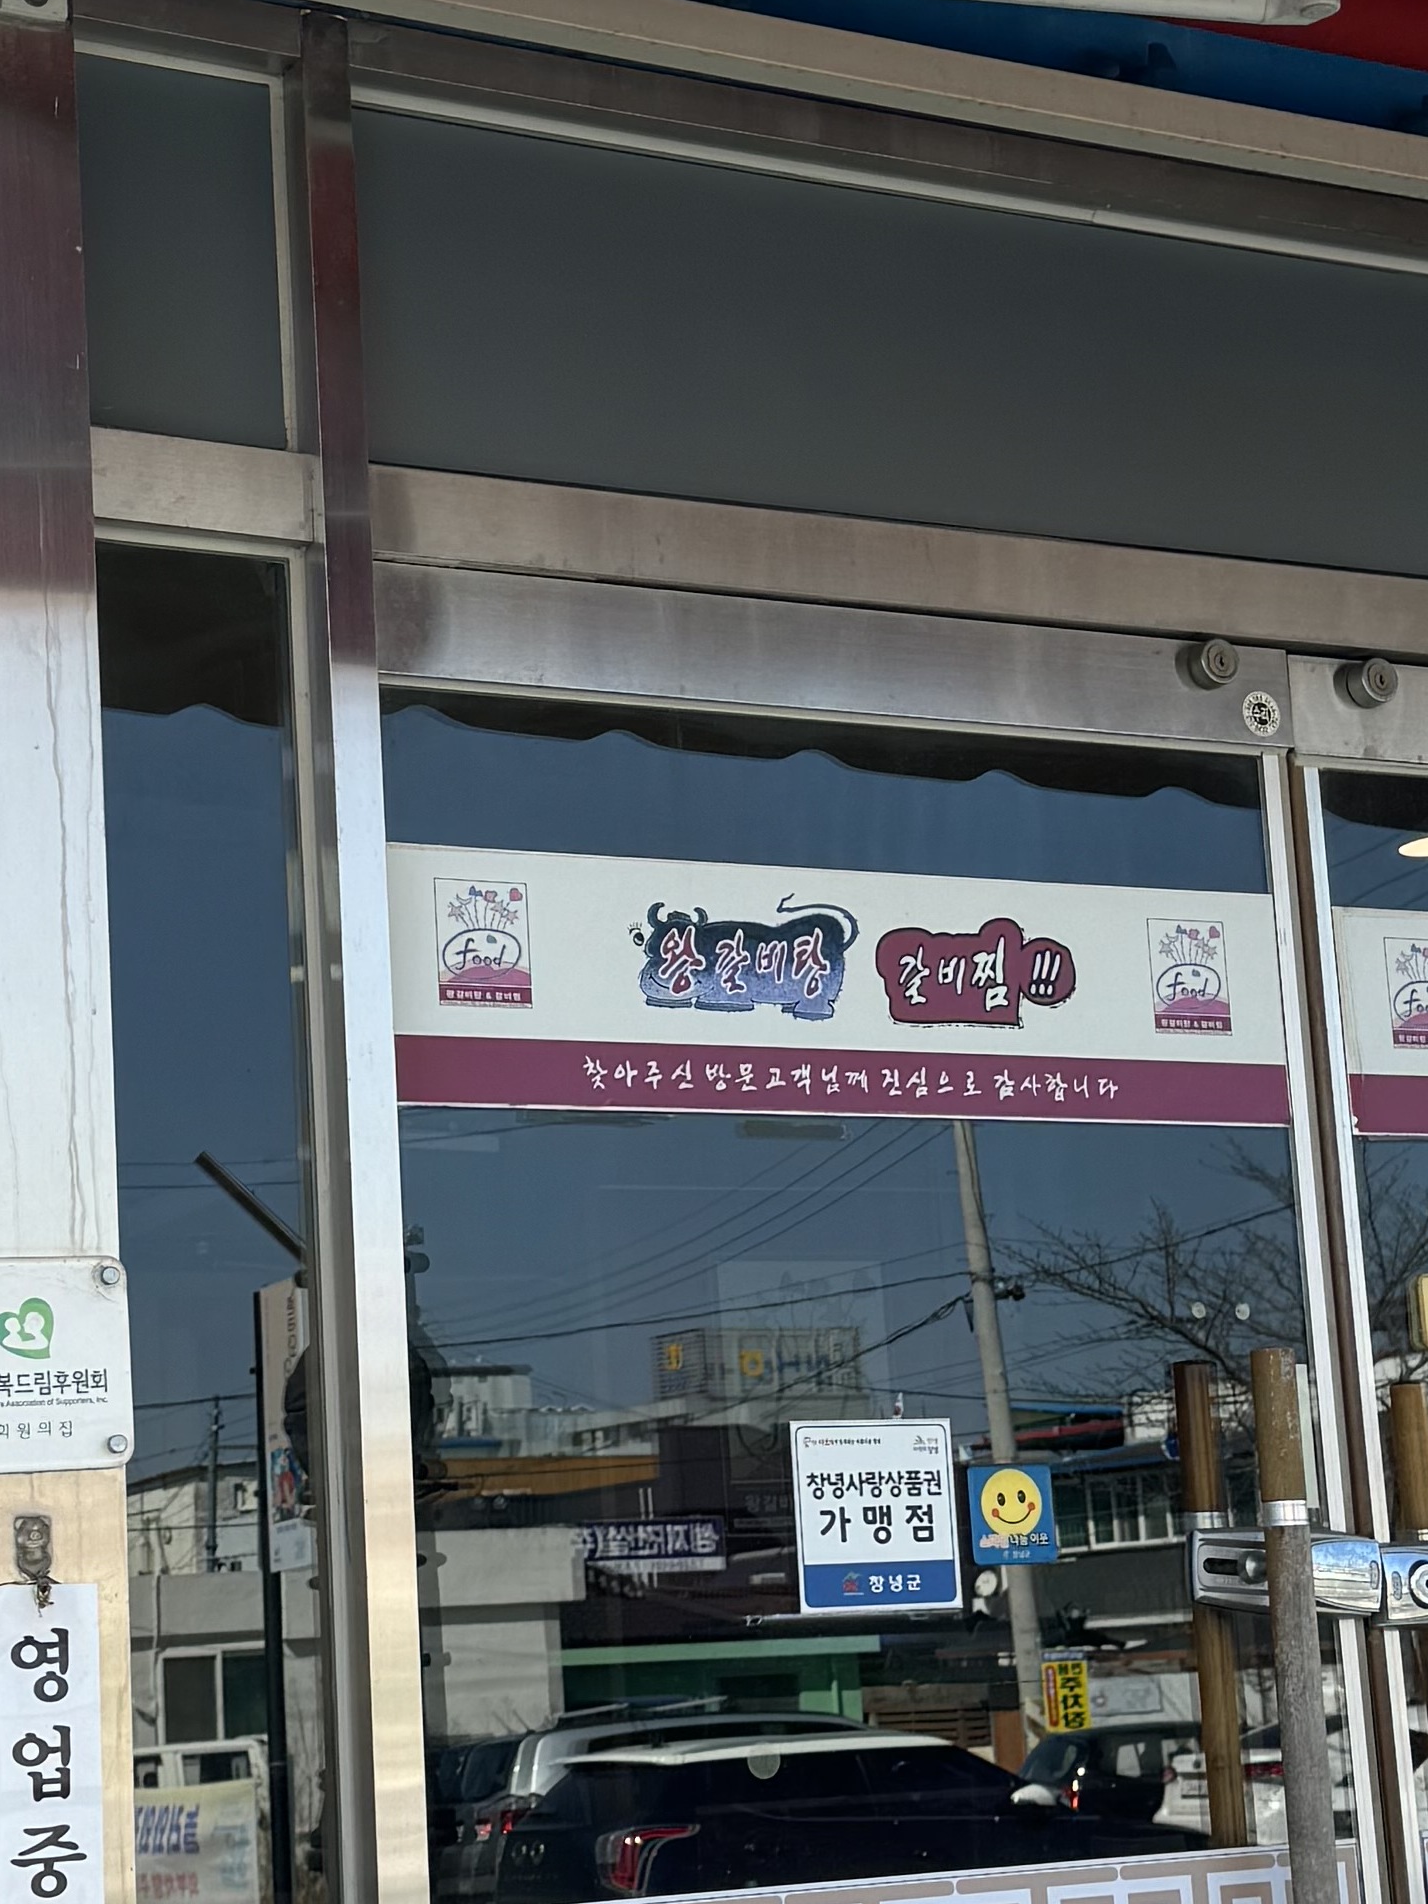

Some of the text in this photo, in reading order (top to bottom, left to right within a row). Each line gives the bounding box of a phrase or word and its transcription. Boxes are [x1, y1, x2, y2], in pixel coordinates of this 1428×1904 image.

[453, 938, 507, 970] food
[1166, 972, 1208, 1001] food
[583, 1055, 694, 1091] 찾아주신
[881, 1069, 982, 1098] 진심으로
[994, 1073, 1119, 1101] 감사합니다
[806, 1469, 942, 1499] 창녕사랑상품권
[819, 1504, 935, 1544] 가맹점
[868, 1574, 922, 1592] 창녕군
[10, 1627, 88, 1899] 영업중
